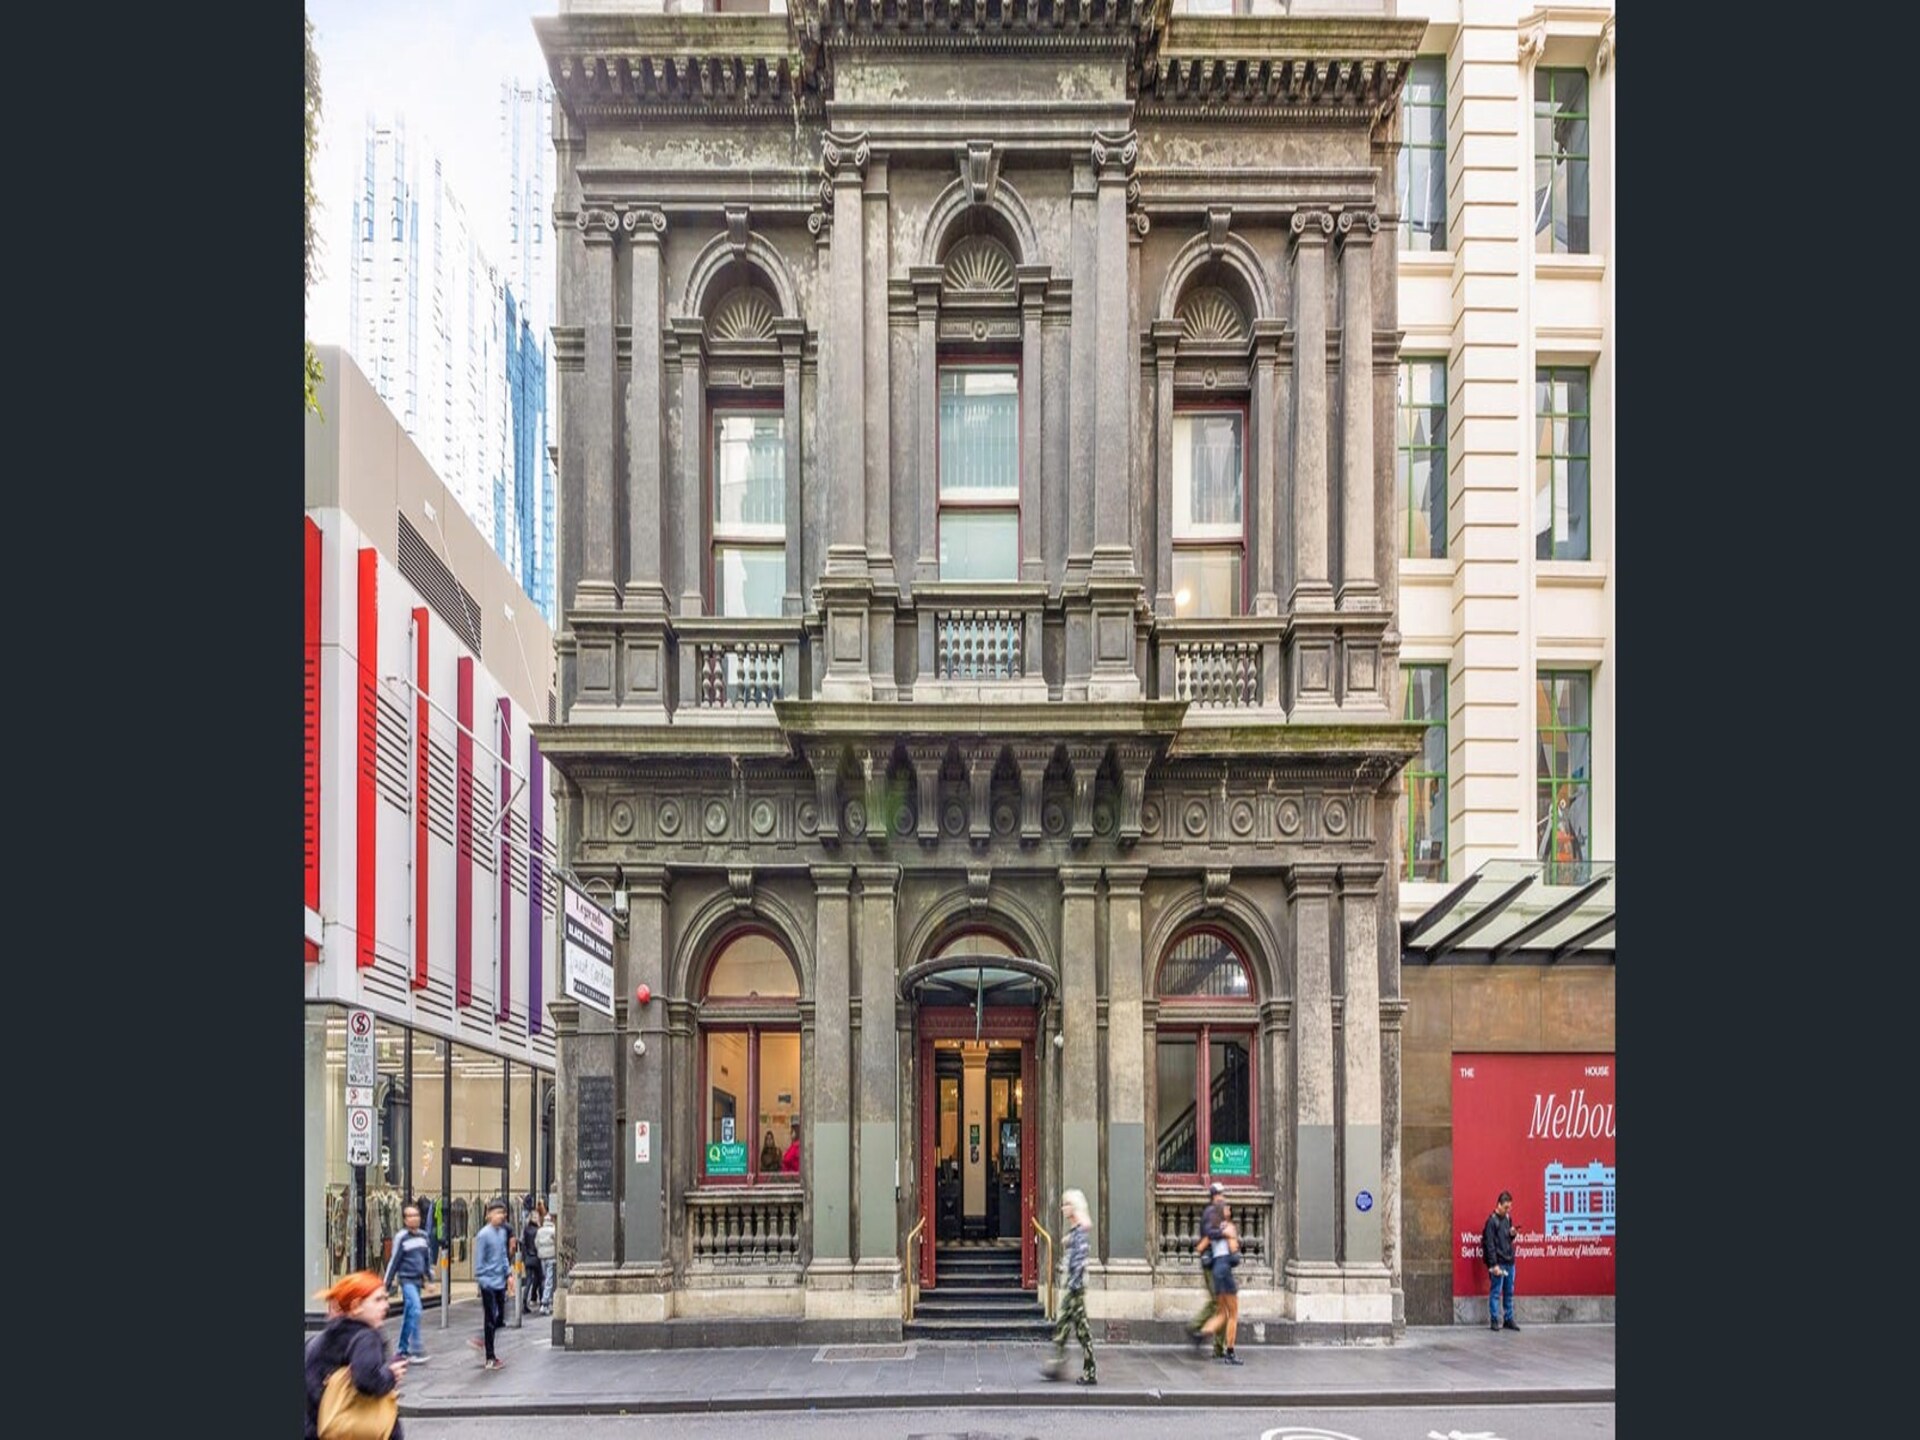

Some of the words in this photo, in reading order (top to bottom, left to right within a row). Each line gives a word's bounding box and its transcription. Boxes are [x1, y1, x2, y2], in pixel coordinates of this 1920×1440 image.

[1460, 1068, 1474, 1078] THE
[1585, 1066, 1609, 1076] HOUSE
[356, 1116, 364, 1126] 10
[1461, 1246, 1475, 1258] Set
